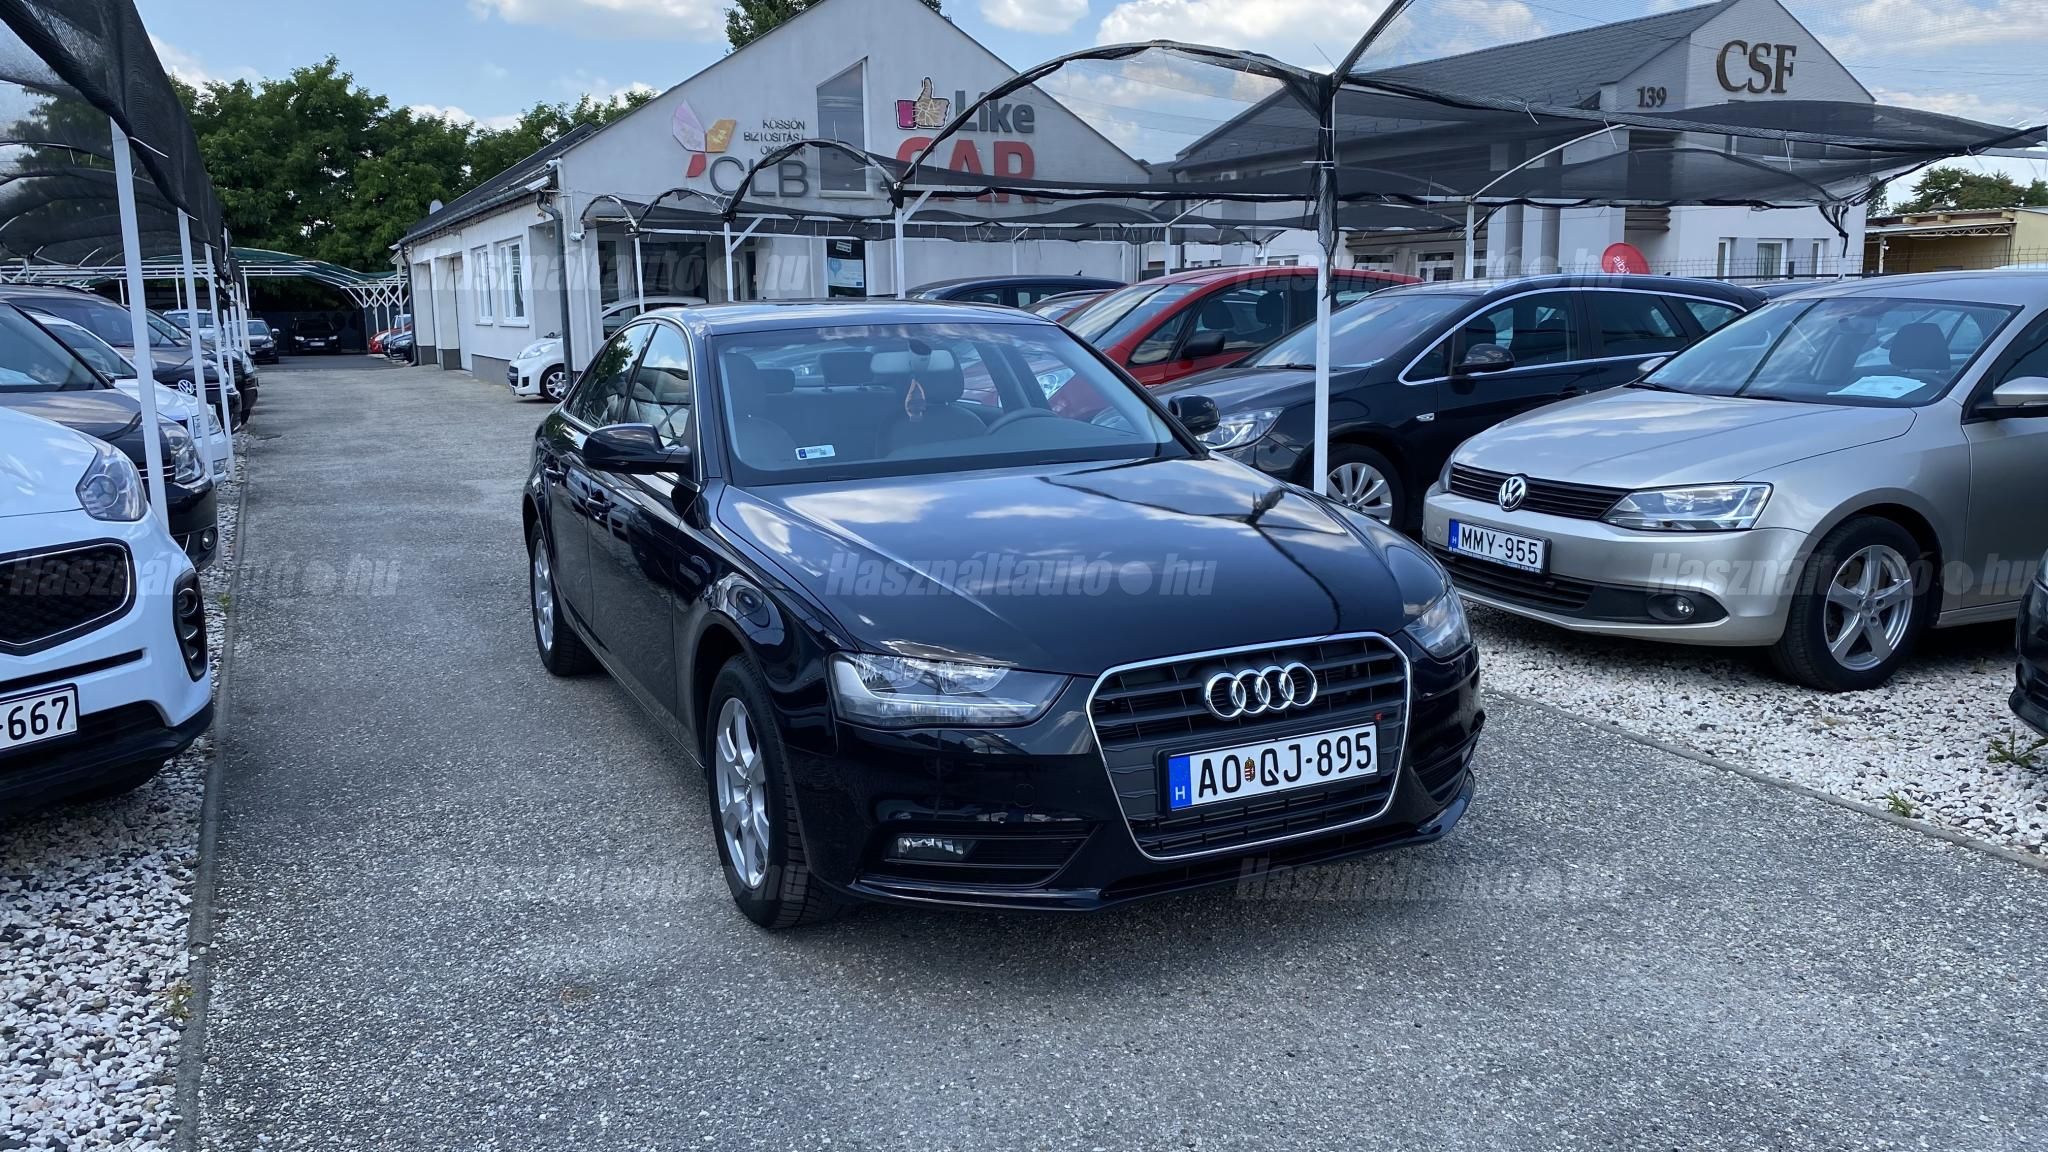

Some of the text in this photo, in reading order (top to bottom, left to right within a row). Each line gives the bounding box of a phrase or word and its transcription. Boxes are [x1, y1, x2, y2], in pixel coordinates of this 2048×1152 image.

[1716, 39, 1797, 94] CSF
[954, 90, 1035, 134] Like
[1637, 86, 1667, 108] 139
[709, 156, 809, 198] CLB
[1461, 527, 1538, 565] MMY-955
